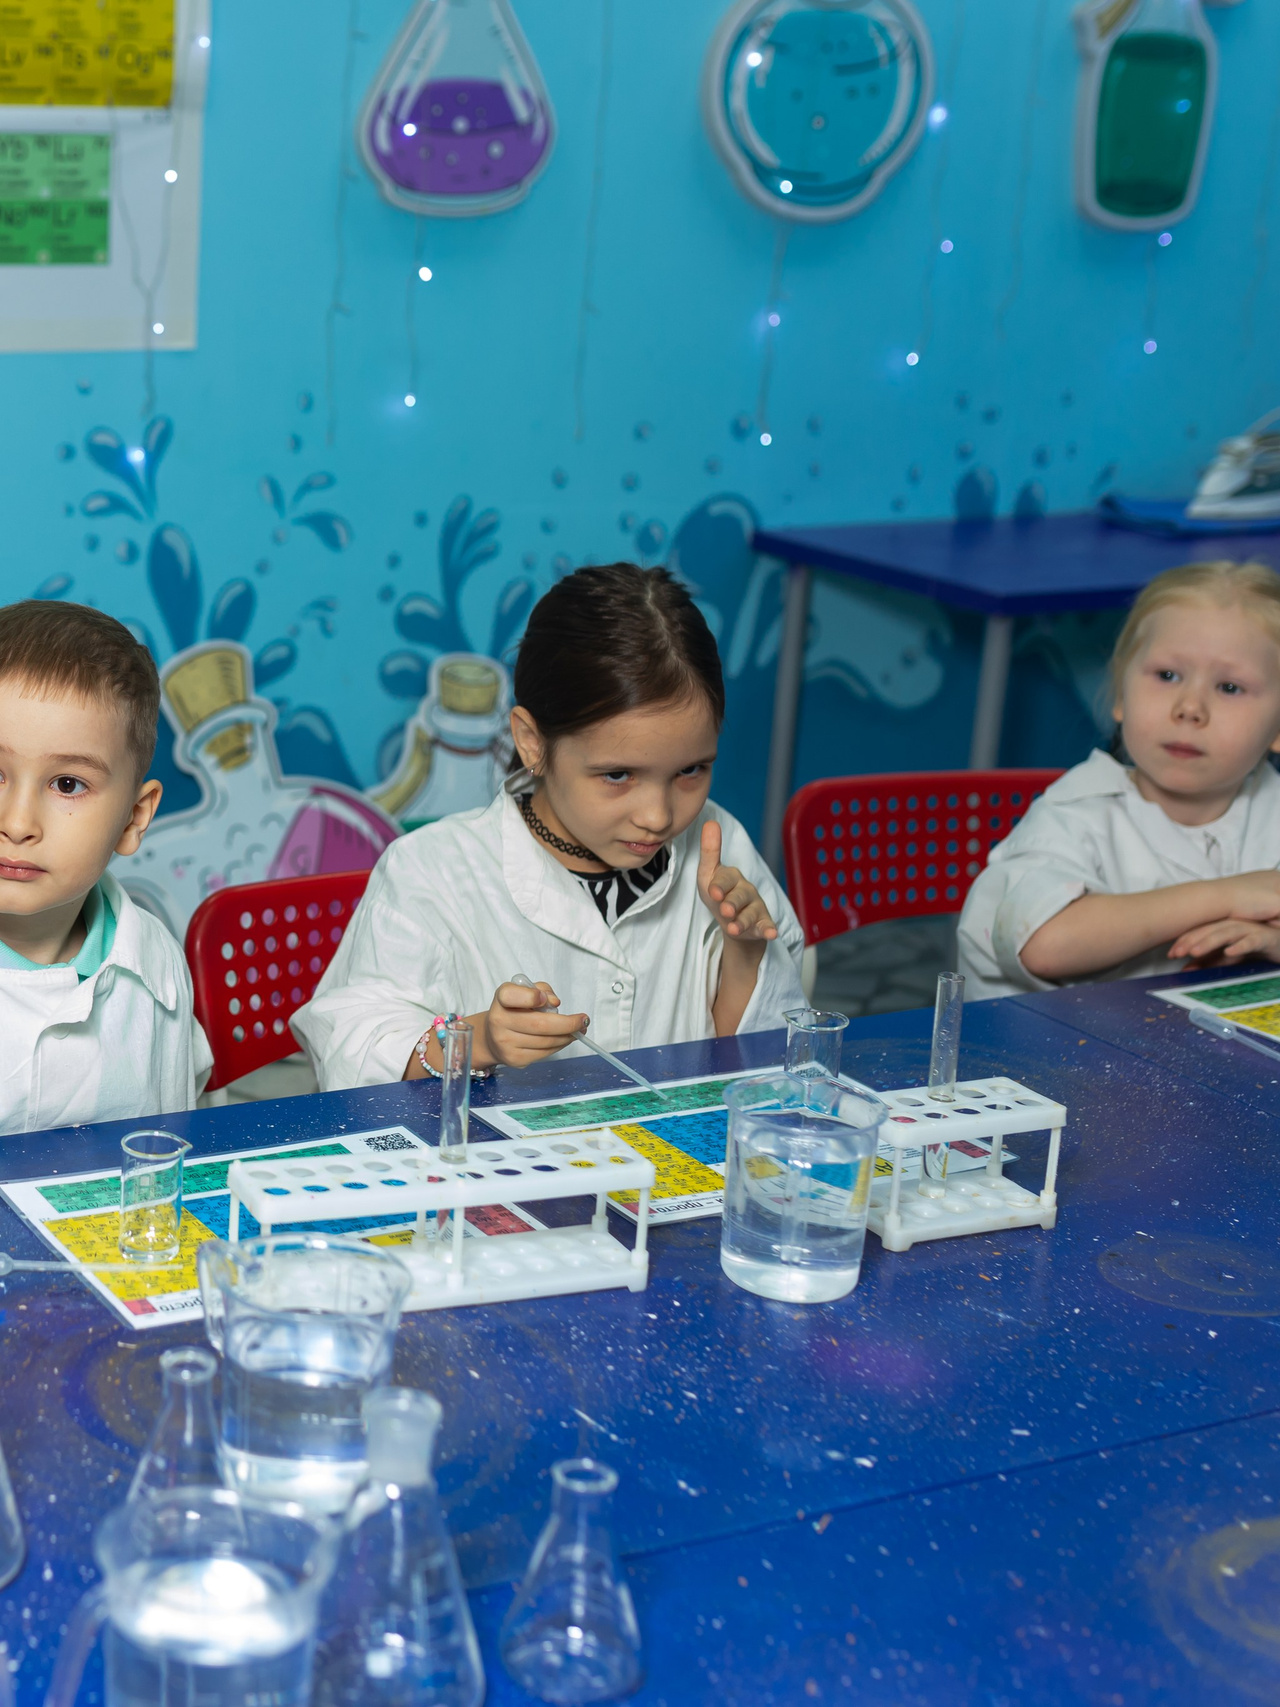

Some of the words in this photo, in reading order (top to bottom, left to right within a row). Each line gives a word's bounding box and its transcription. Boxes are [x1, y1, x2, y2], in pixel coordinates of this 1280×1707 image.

[52, 134, 85, 163] Lu
[656, 1201, 704, 1213] просто
[160, 1296, 203, 1312] росто
